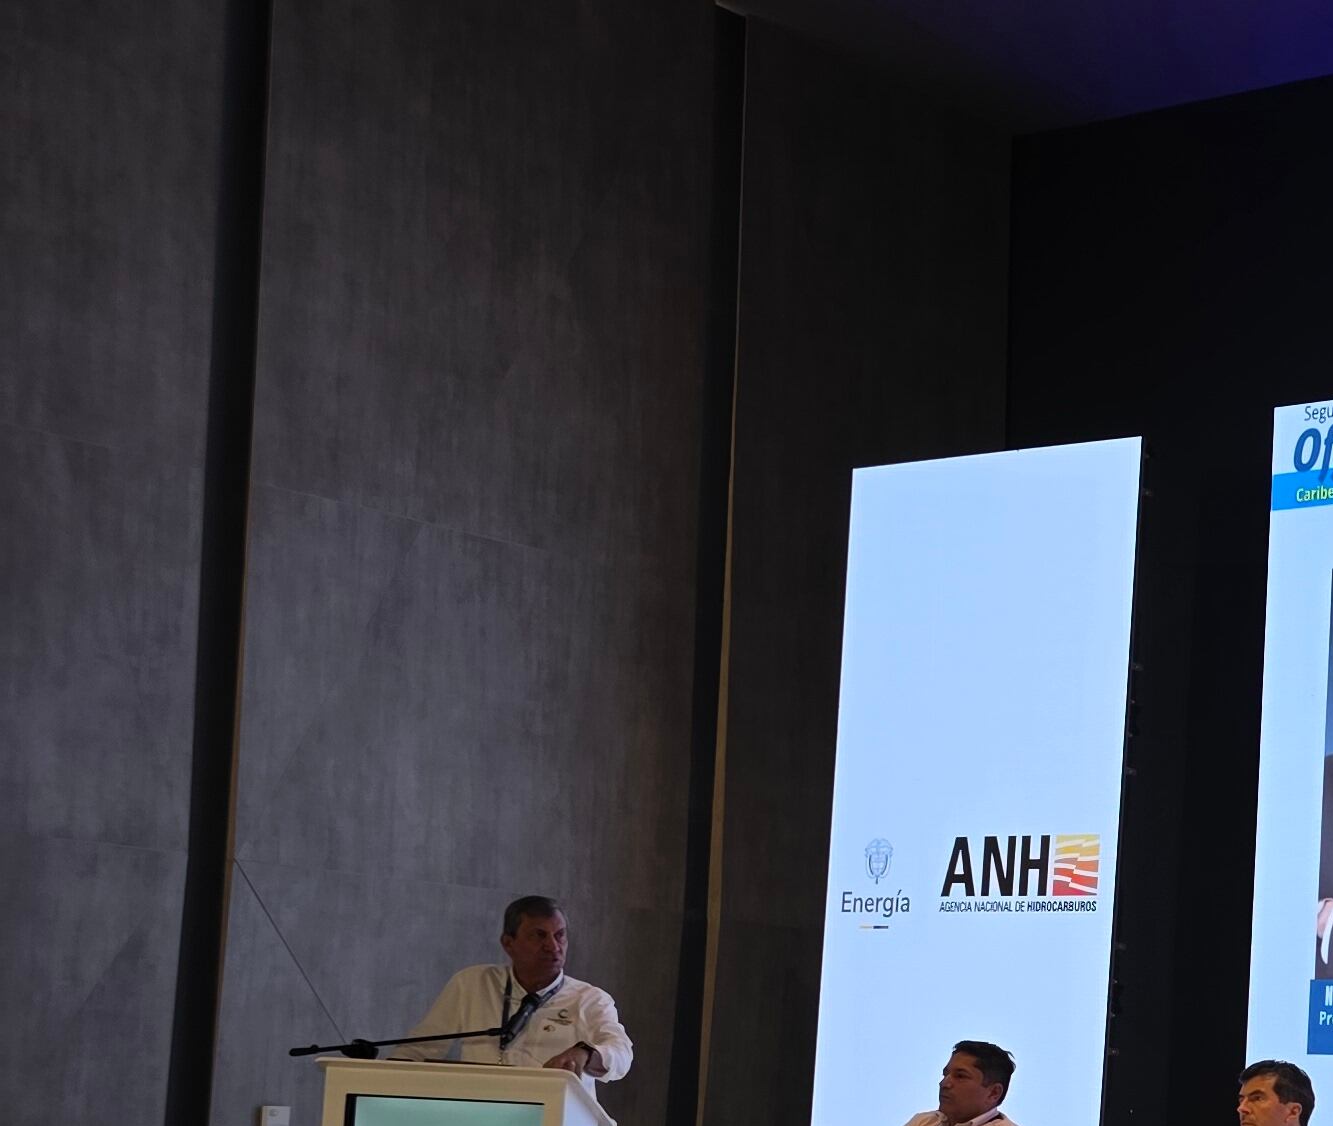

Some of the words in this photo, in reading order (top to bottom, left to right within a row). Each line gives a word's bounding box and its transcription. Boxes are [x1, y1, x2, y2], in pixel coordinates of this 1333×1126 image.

[940, 835, 1050, 897] ANH
[841, 888, 910, 917] Energía
[939, 901, 972, 912] AGENCIA
[974, 901, 1012, 912] NACIONAL
[1015, 901, 1025, 912] DE
[1026, 901, 1097, 912] HIDROCARBUROS
